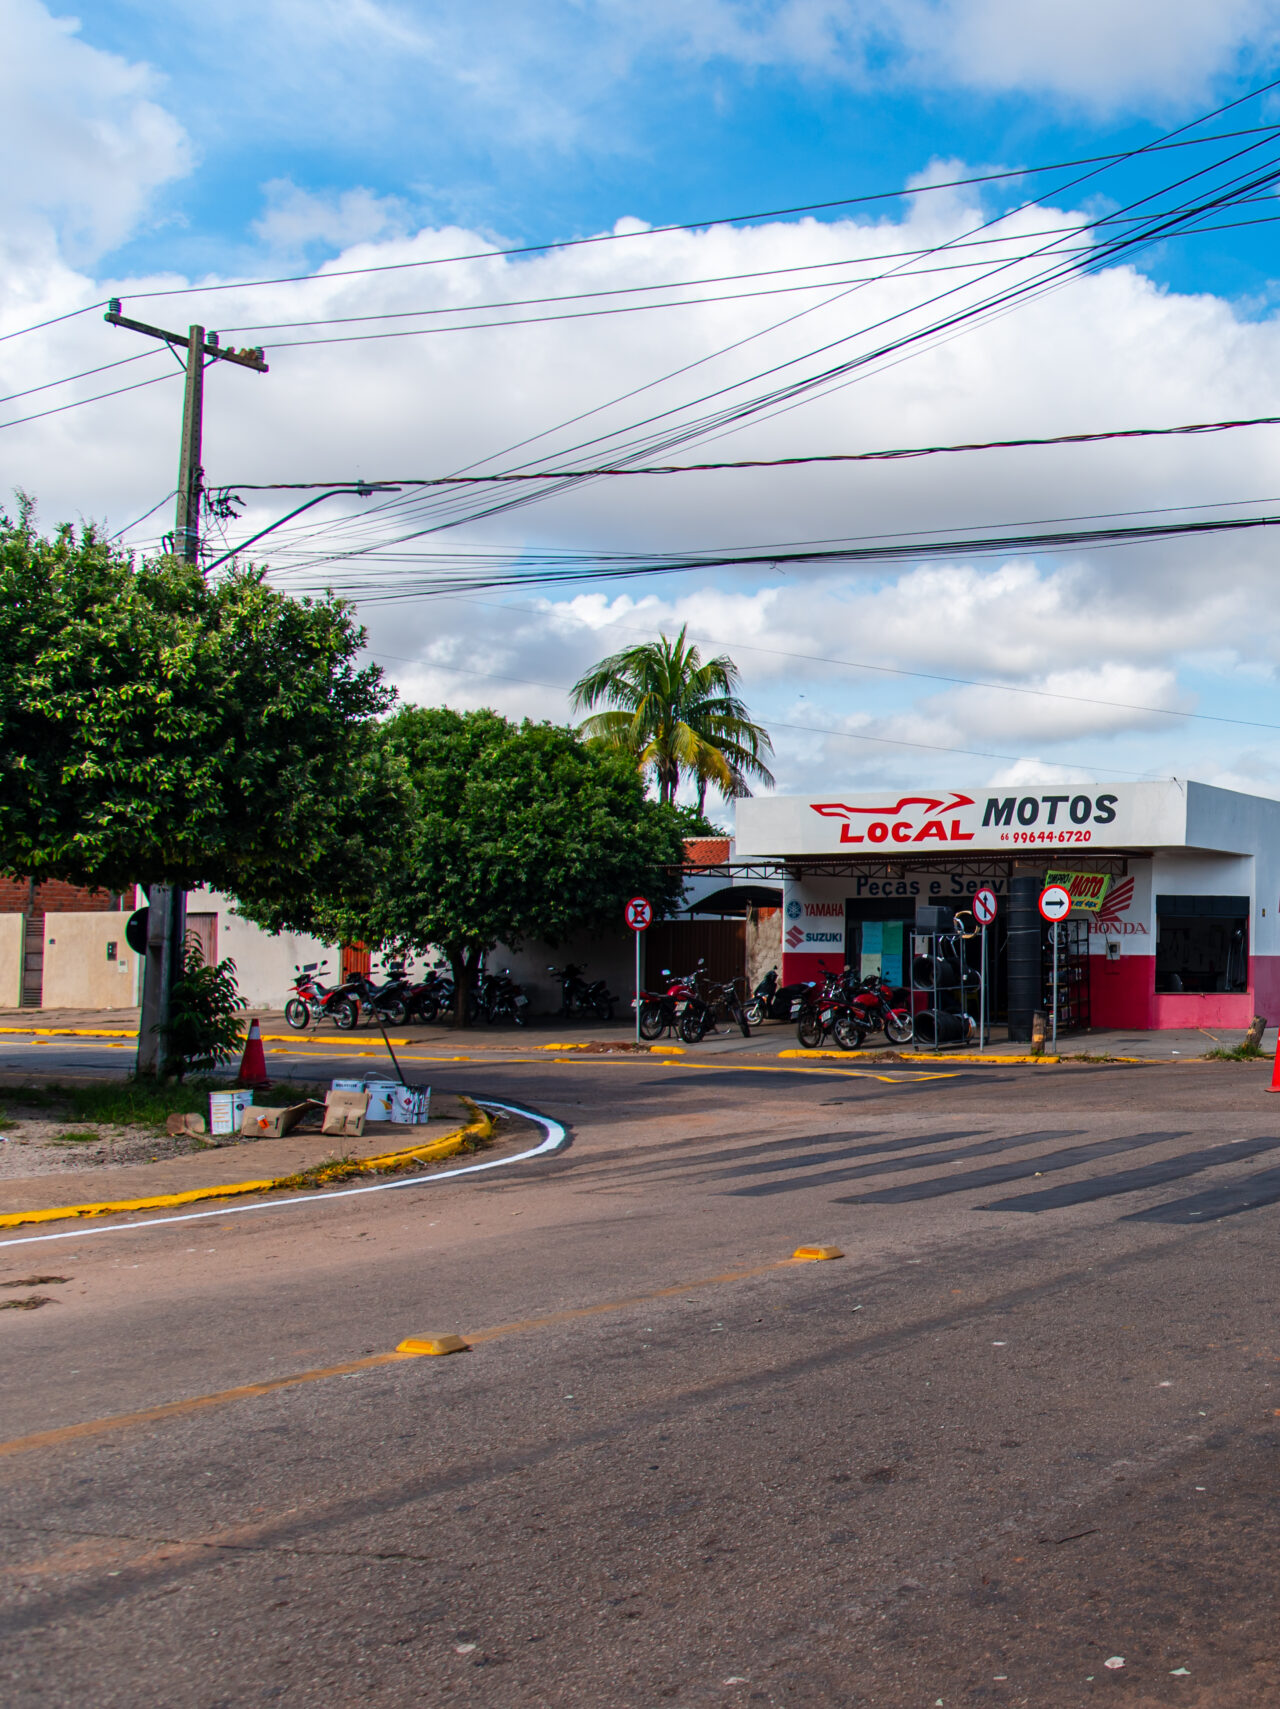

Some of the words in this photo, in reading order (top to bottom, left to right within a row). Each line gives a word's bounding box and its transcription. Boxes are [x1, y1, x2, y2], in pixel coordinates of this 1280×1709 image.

[981, 794, 1119, 827] MOTOS
[840, 819, 976, 843] LOCAL
[856, 876, 920, 898] Peças
[929, 880, 942, 895] e
[1069, 874, 1104, 899] MOTO
[803, 903, 844, 917] YAMAHA
[805, 932, 842, 943] SUZUKI
[1089, 922, 1151, 935] HONDA
